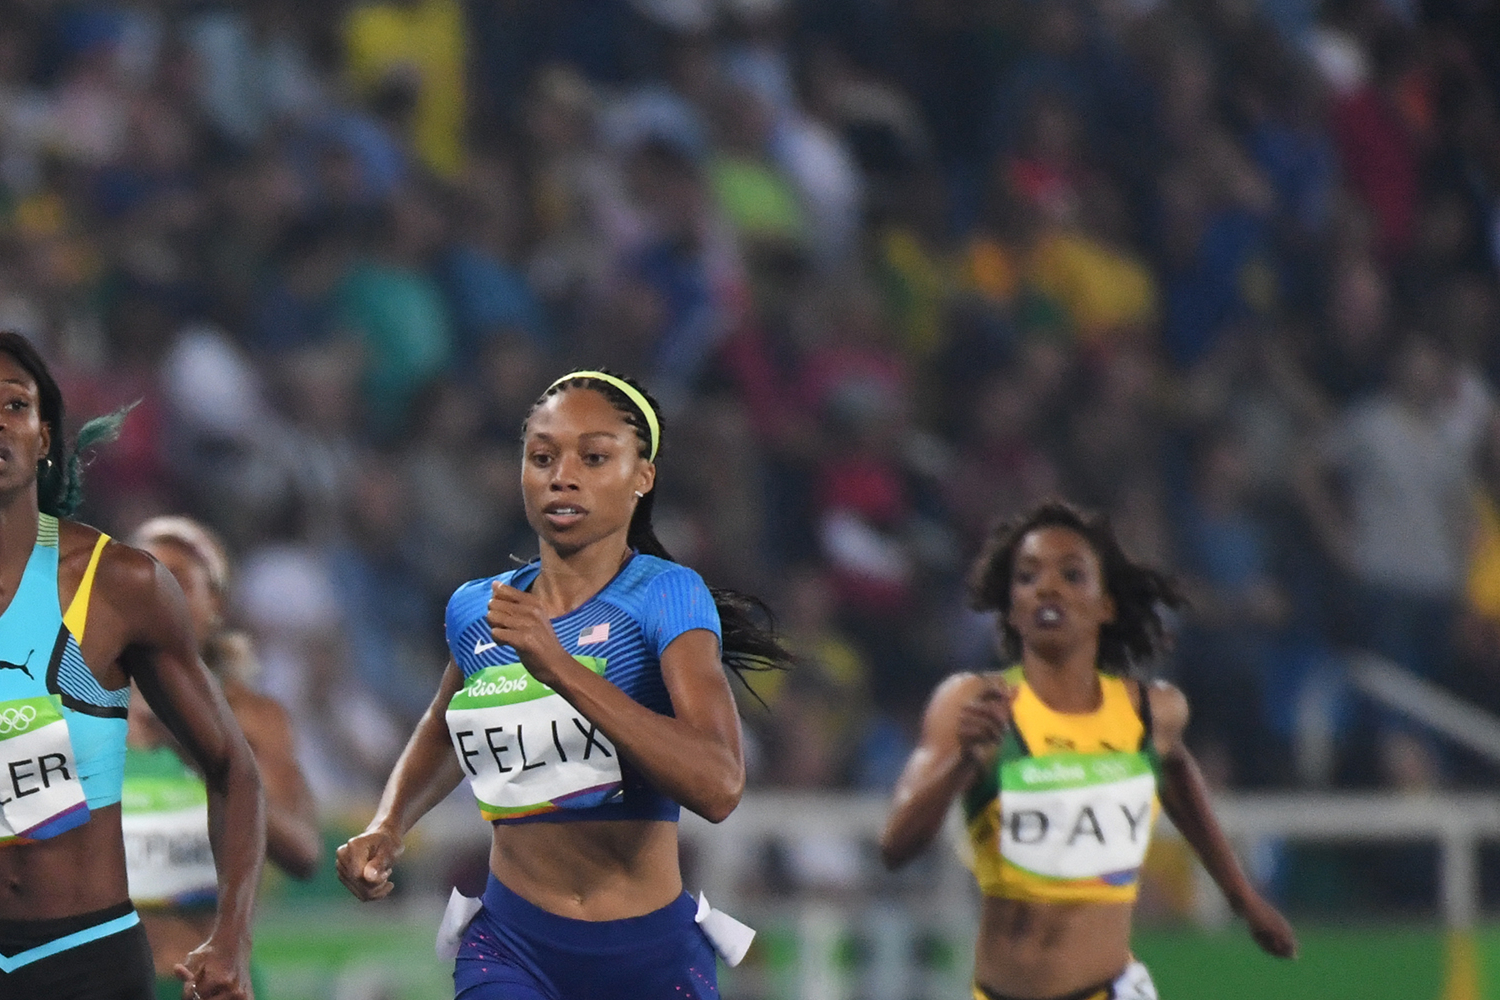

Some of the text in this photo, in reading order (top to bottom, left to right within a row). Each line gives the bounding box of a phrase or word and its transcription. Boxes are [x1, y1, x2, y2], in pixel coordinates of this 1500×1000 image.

[467, 674, 529, 698] Rio2016
[456, 717, 613, 776] FELIX
[1010, 803, 1149, 846] DAY
